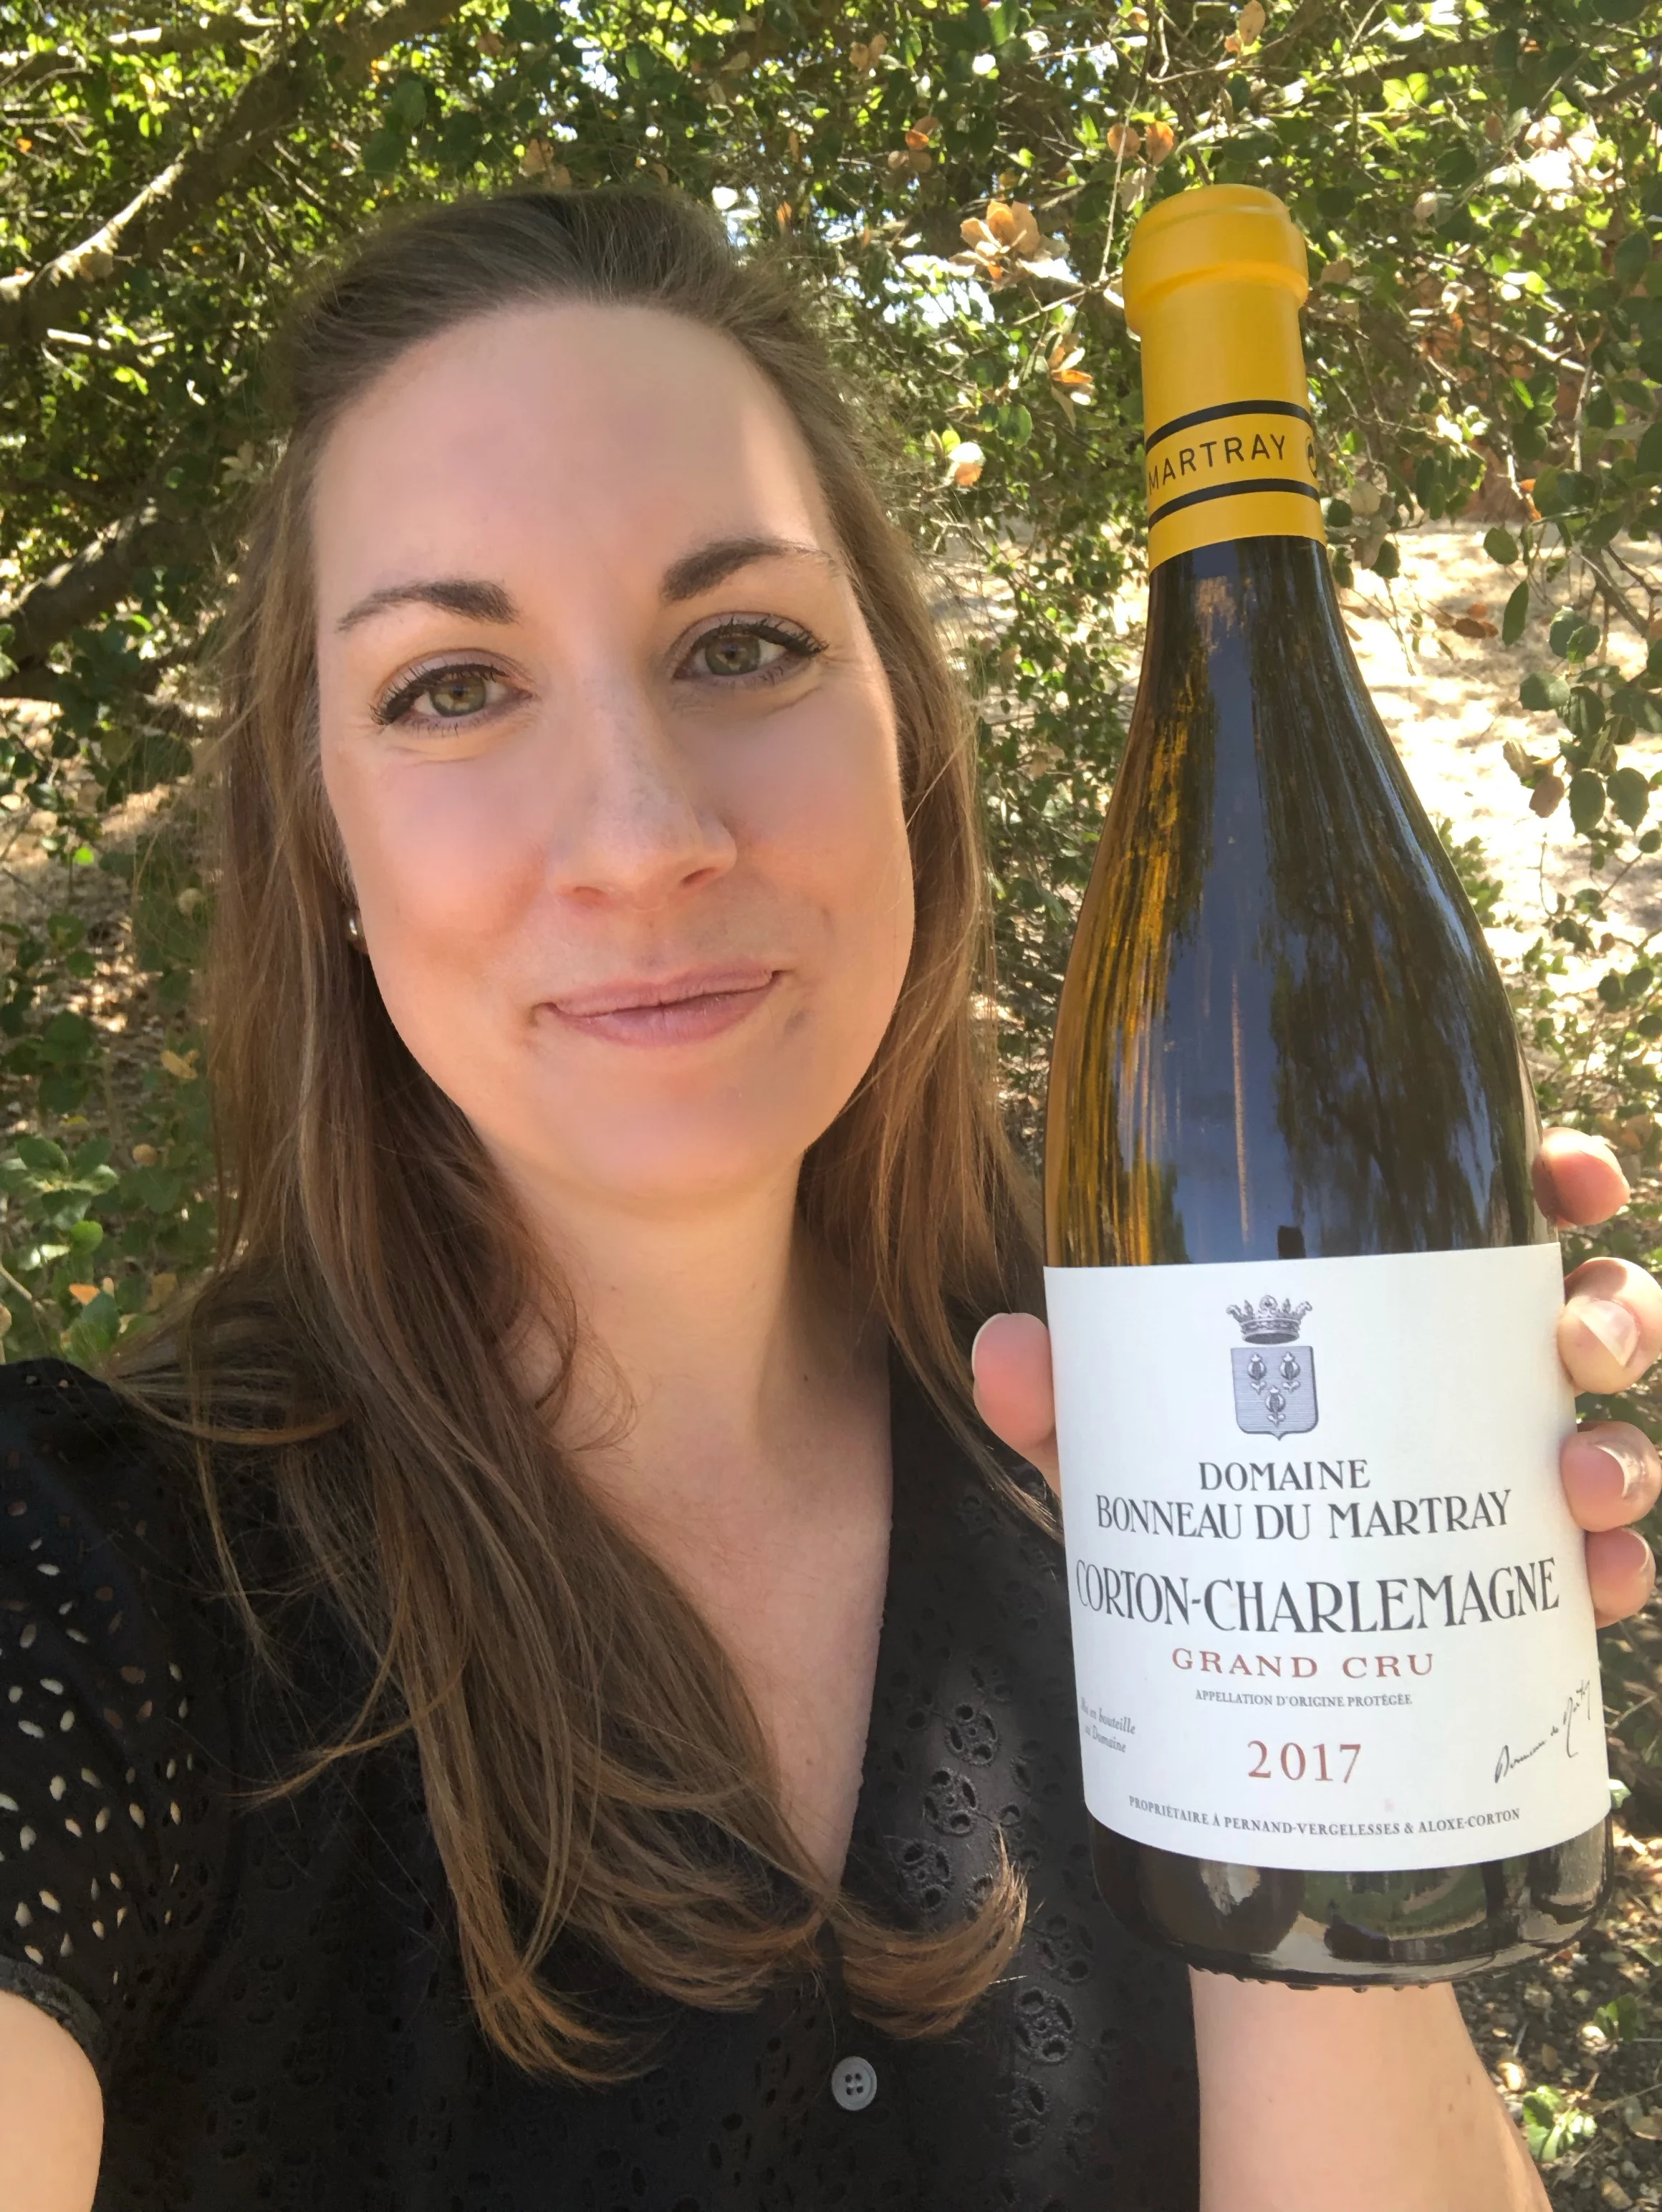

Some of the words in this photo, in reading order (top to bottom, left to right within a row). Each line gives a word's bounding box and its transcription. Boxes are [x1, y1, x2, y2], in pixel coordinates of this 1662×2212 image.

[1148, 433, 1286, 496] MARTRAY
[1199, 1458, 1371, 1491] DOMAINE
[1095, 1494, 1243, 1540] BONNEAU
[1254, 1503, 1312, 1541] DU
[1327, 1489, 1512, 1539] MARTRAY
[1076, 1557, 1560, 1633] CORTON-CHARLEMAGNE
[1172, 1648, 1318, 1678] GRAND
[1342, 1653, 1433, 1679] CRU
[1195, 1689, 1273, 1706] APPELLATION
[1276, 1694, 1345, 1708] D'ORIGINE
[1348, 1693, 1413, 1708] PROTÉGÉE
[1246, 1739, 1362, 1784] 2017
[1128, 1794, 1209, 1825] PROPRIÉTAIRE
[1224, 1816, 1401, 1836] PERNAND-VERGELESSES
[1404, 1822, 1414, 1834] &
[1418, 1807, 1520, 1834] ALOXE-CORTON
